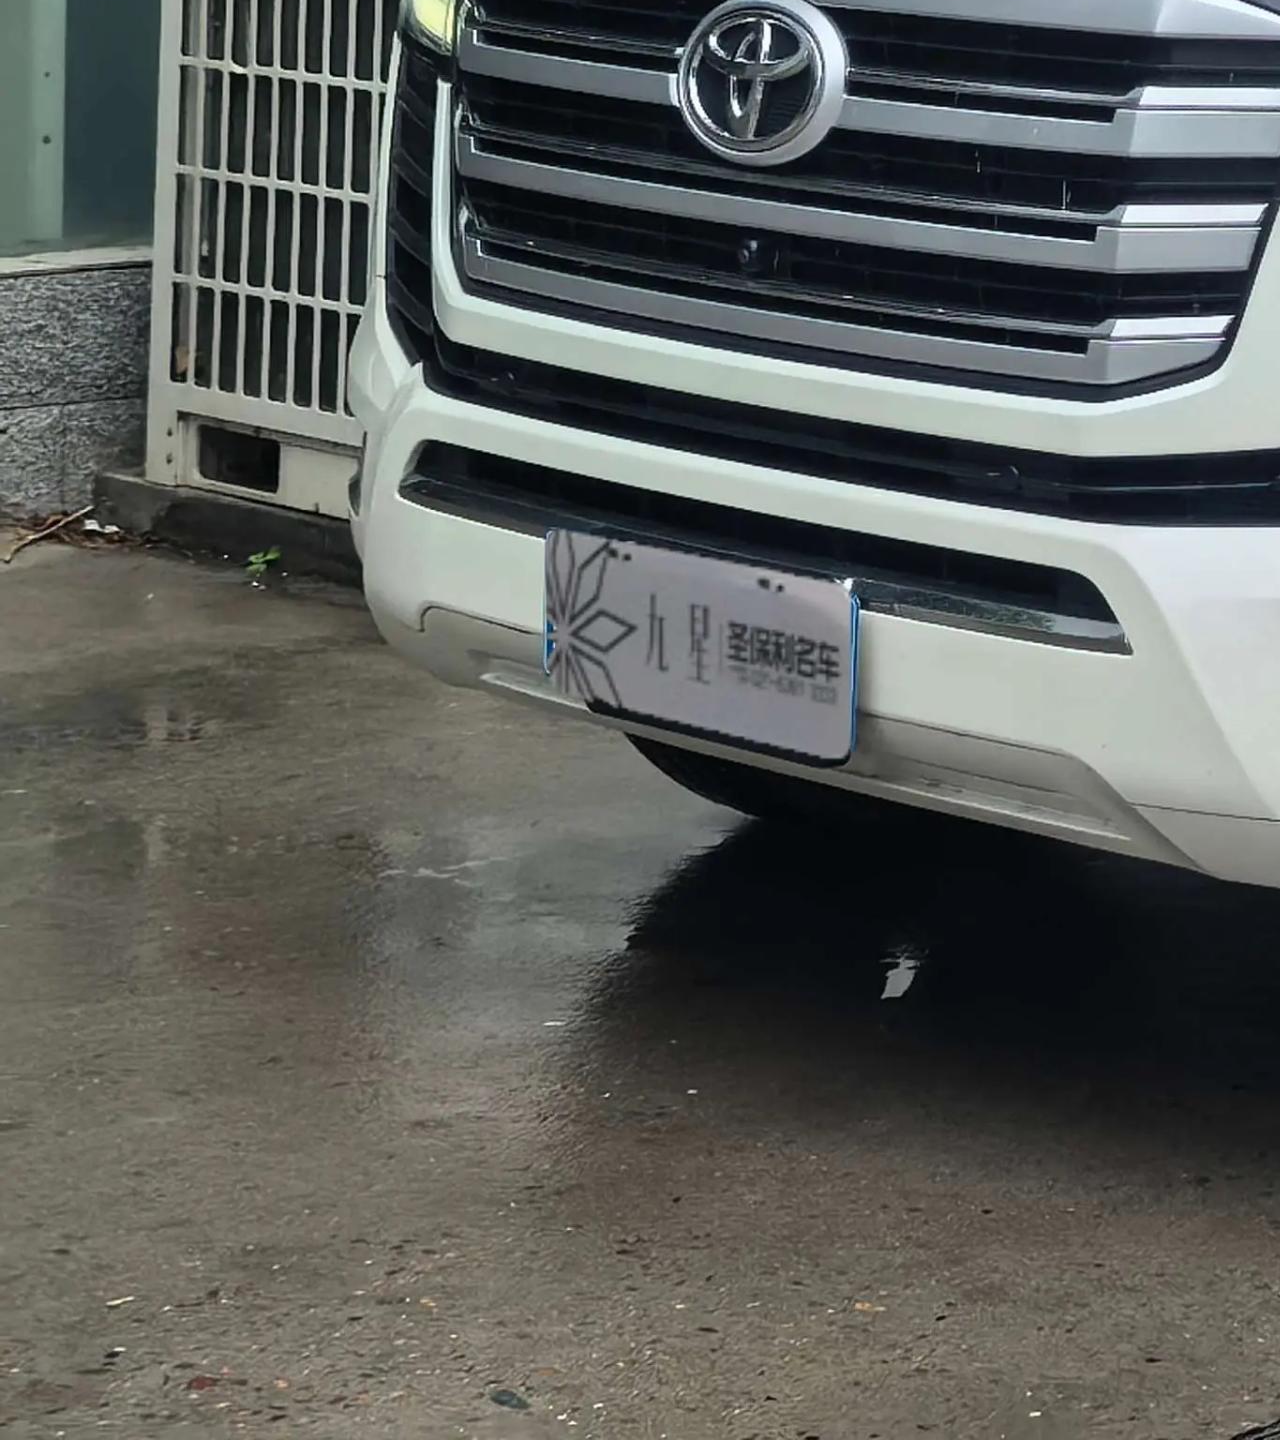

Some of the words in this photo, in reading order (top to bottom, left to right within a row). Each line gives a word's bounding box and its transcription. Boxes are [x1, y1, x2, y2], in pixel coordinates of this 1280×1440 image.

[727, 620, 840, 682] 圣保利名车
